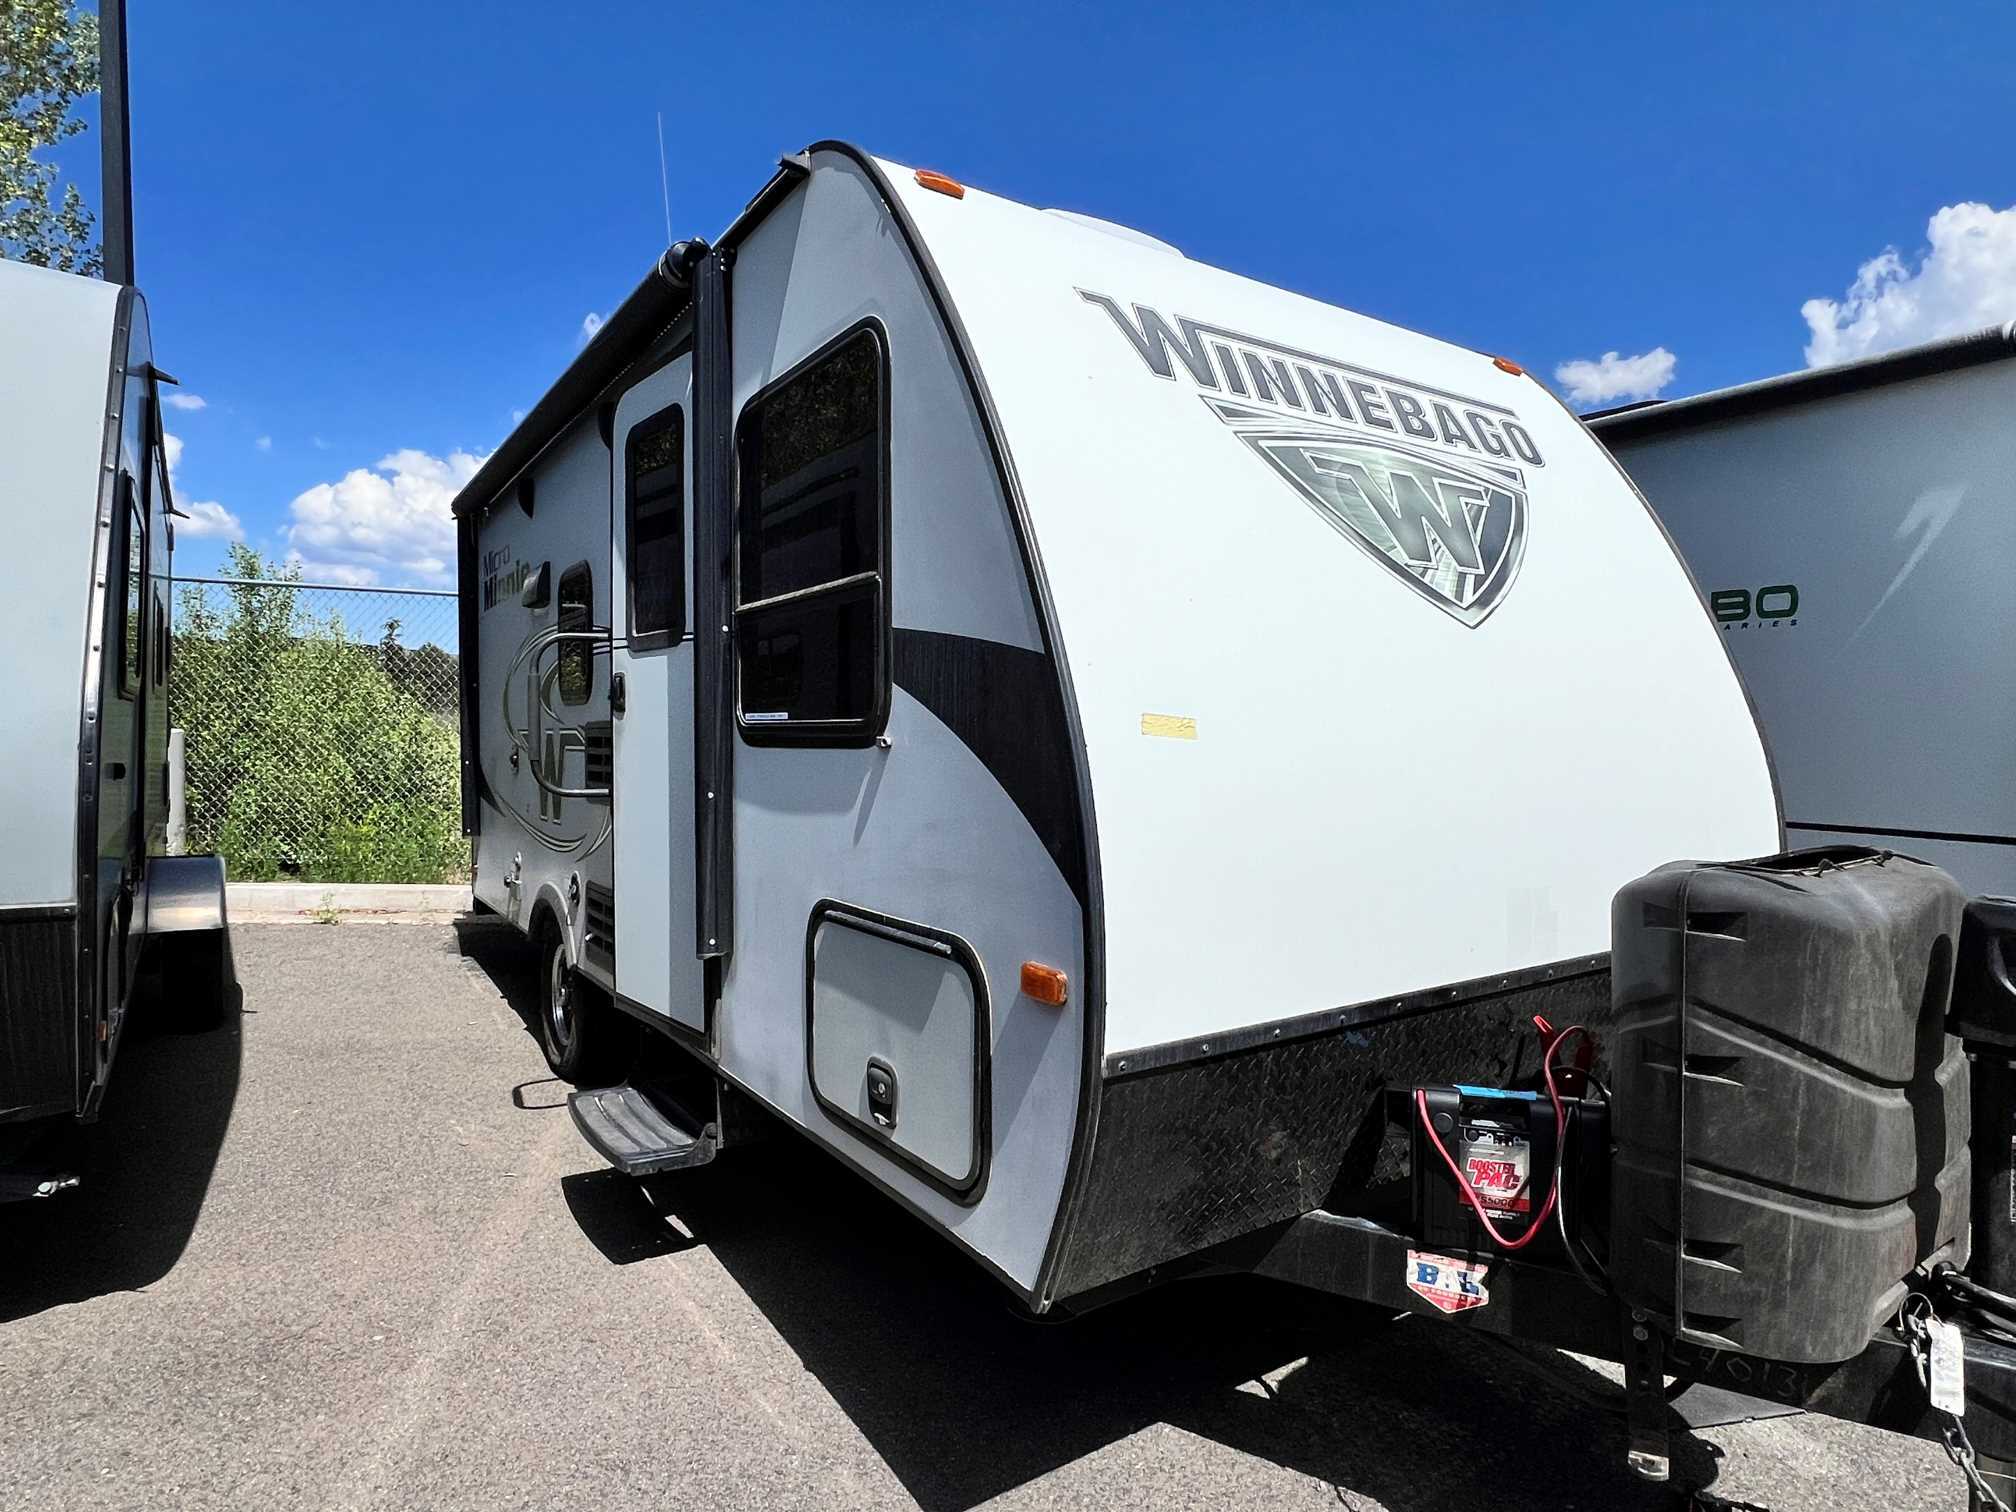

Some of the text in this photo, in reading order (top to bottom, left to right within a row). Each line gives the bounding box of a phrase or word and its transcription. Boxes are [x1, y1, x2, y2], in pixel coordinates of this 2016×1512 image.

[1073, 287, 1546, 467] WINNEBAGO
[1469, 1159, 1516, 1175] BOOSTER
[1473, 1171, 1520, 1190] PAC
